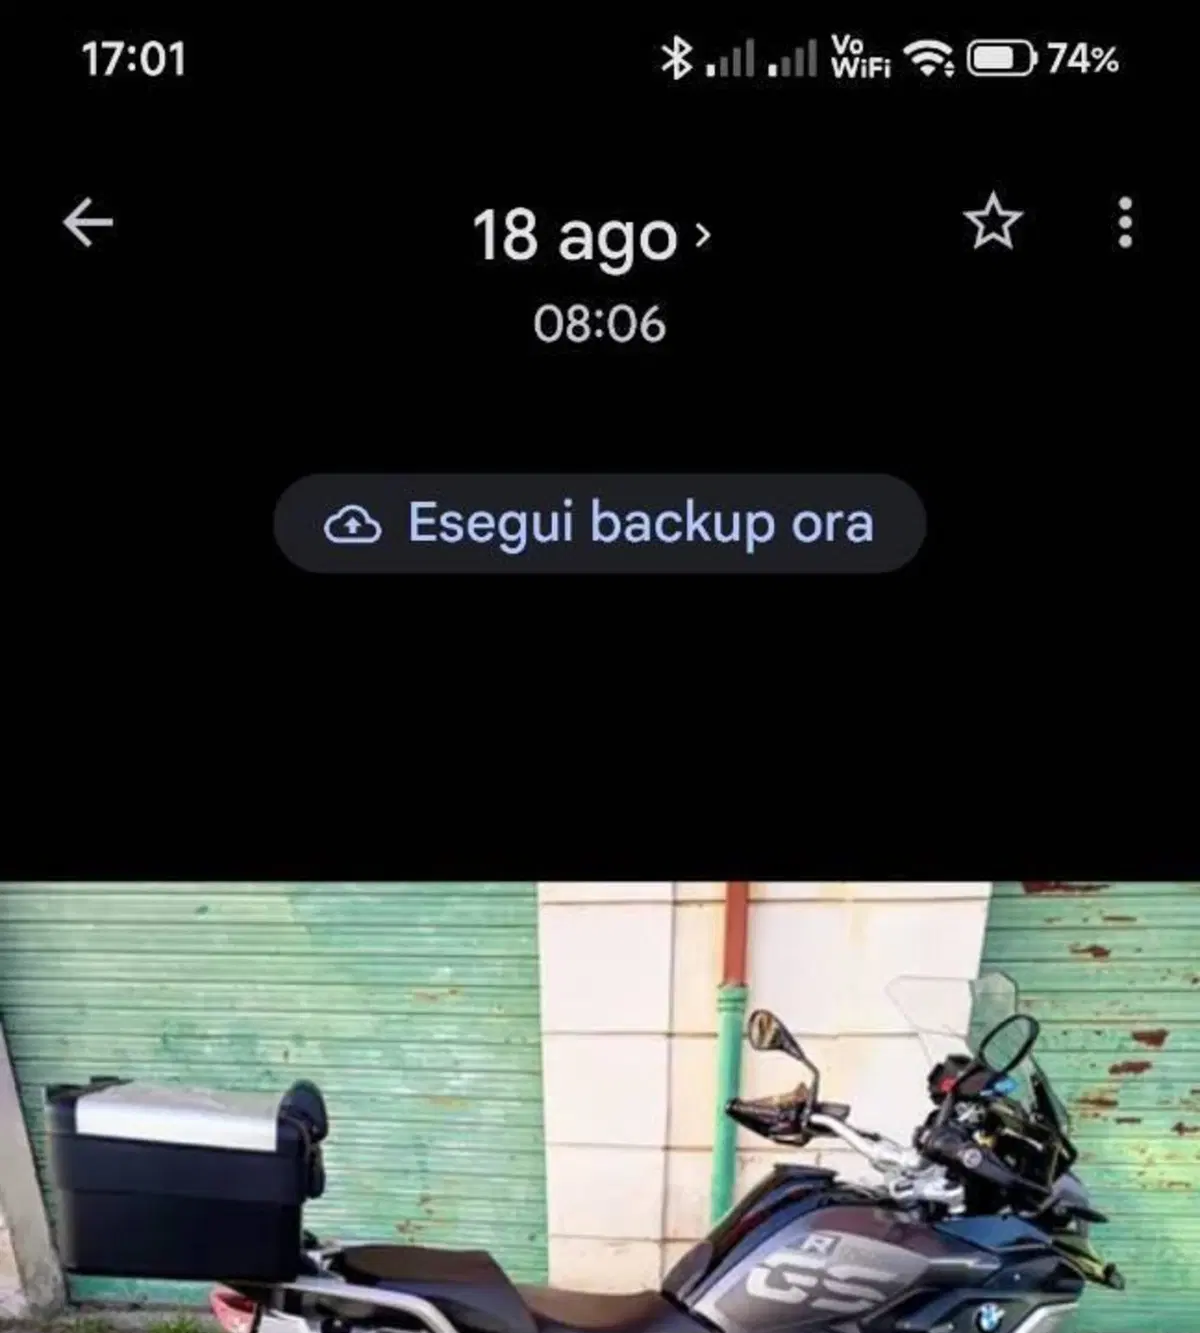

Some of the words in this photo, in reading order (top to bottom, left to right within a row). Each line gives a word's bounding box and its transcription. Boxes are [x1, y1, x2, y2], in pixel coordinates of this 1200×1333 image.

[82, 40, 185, 77] 17:01
[831, 34, 864, 55] Vo
[1047, 42, 1120, 74] 74%
[831, 56, 891, 79] WiFi
[473, 206, 539, 262] 18
[558, 219, 678, 277] ago
[533, 303, 667, 344] 08:06
[409, 498, 574, 555] Esegui
[591, 496, 776, 555] backup
[791, 509, 874, 543] ora
[745, 1252, 898, 1314] GS
